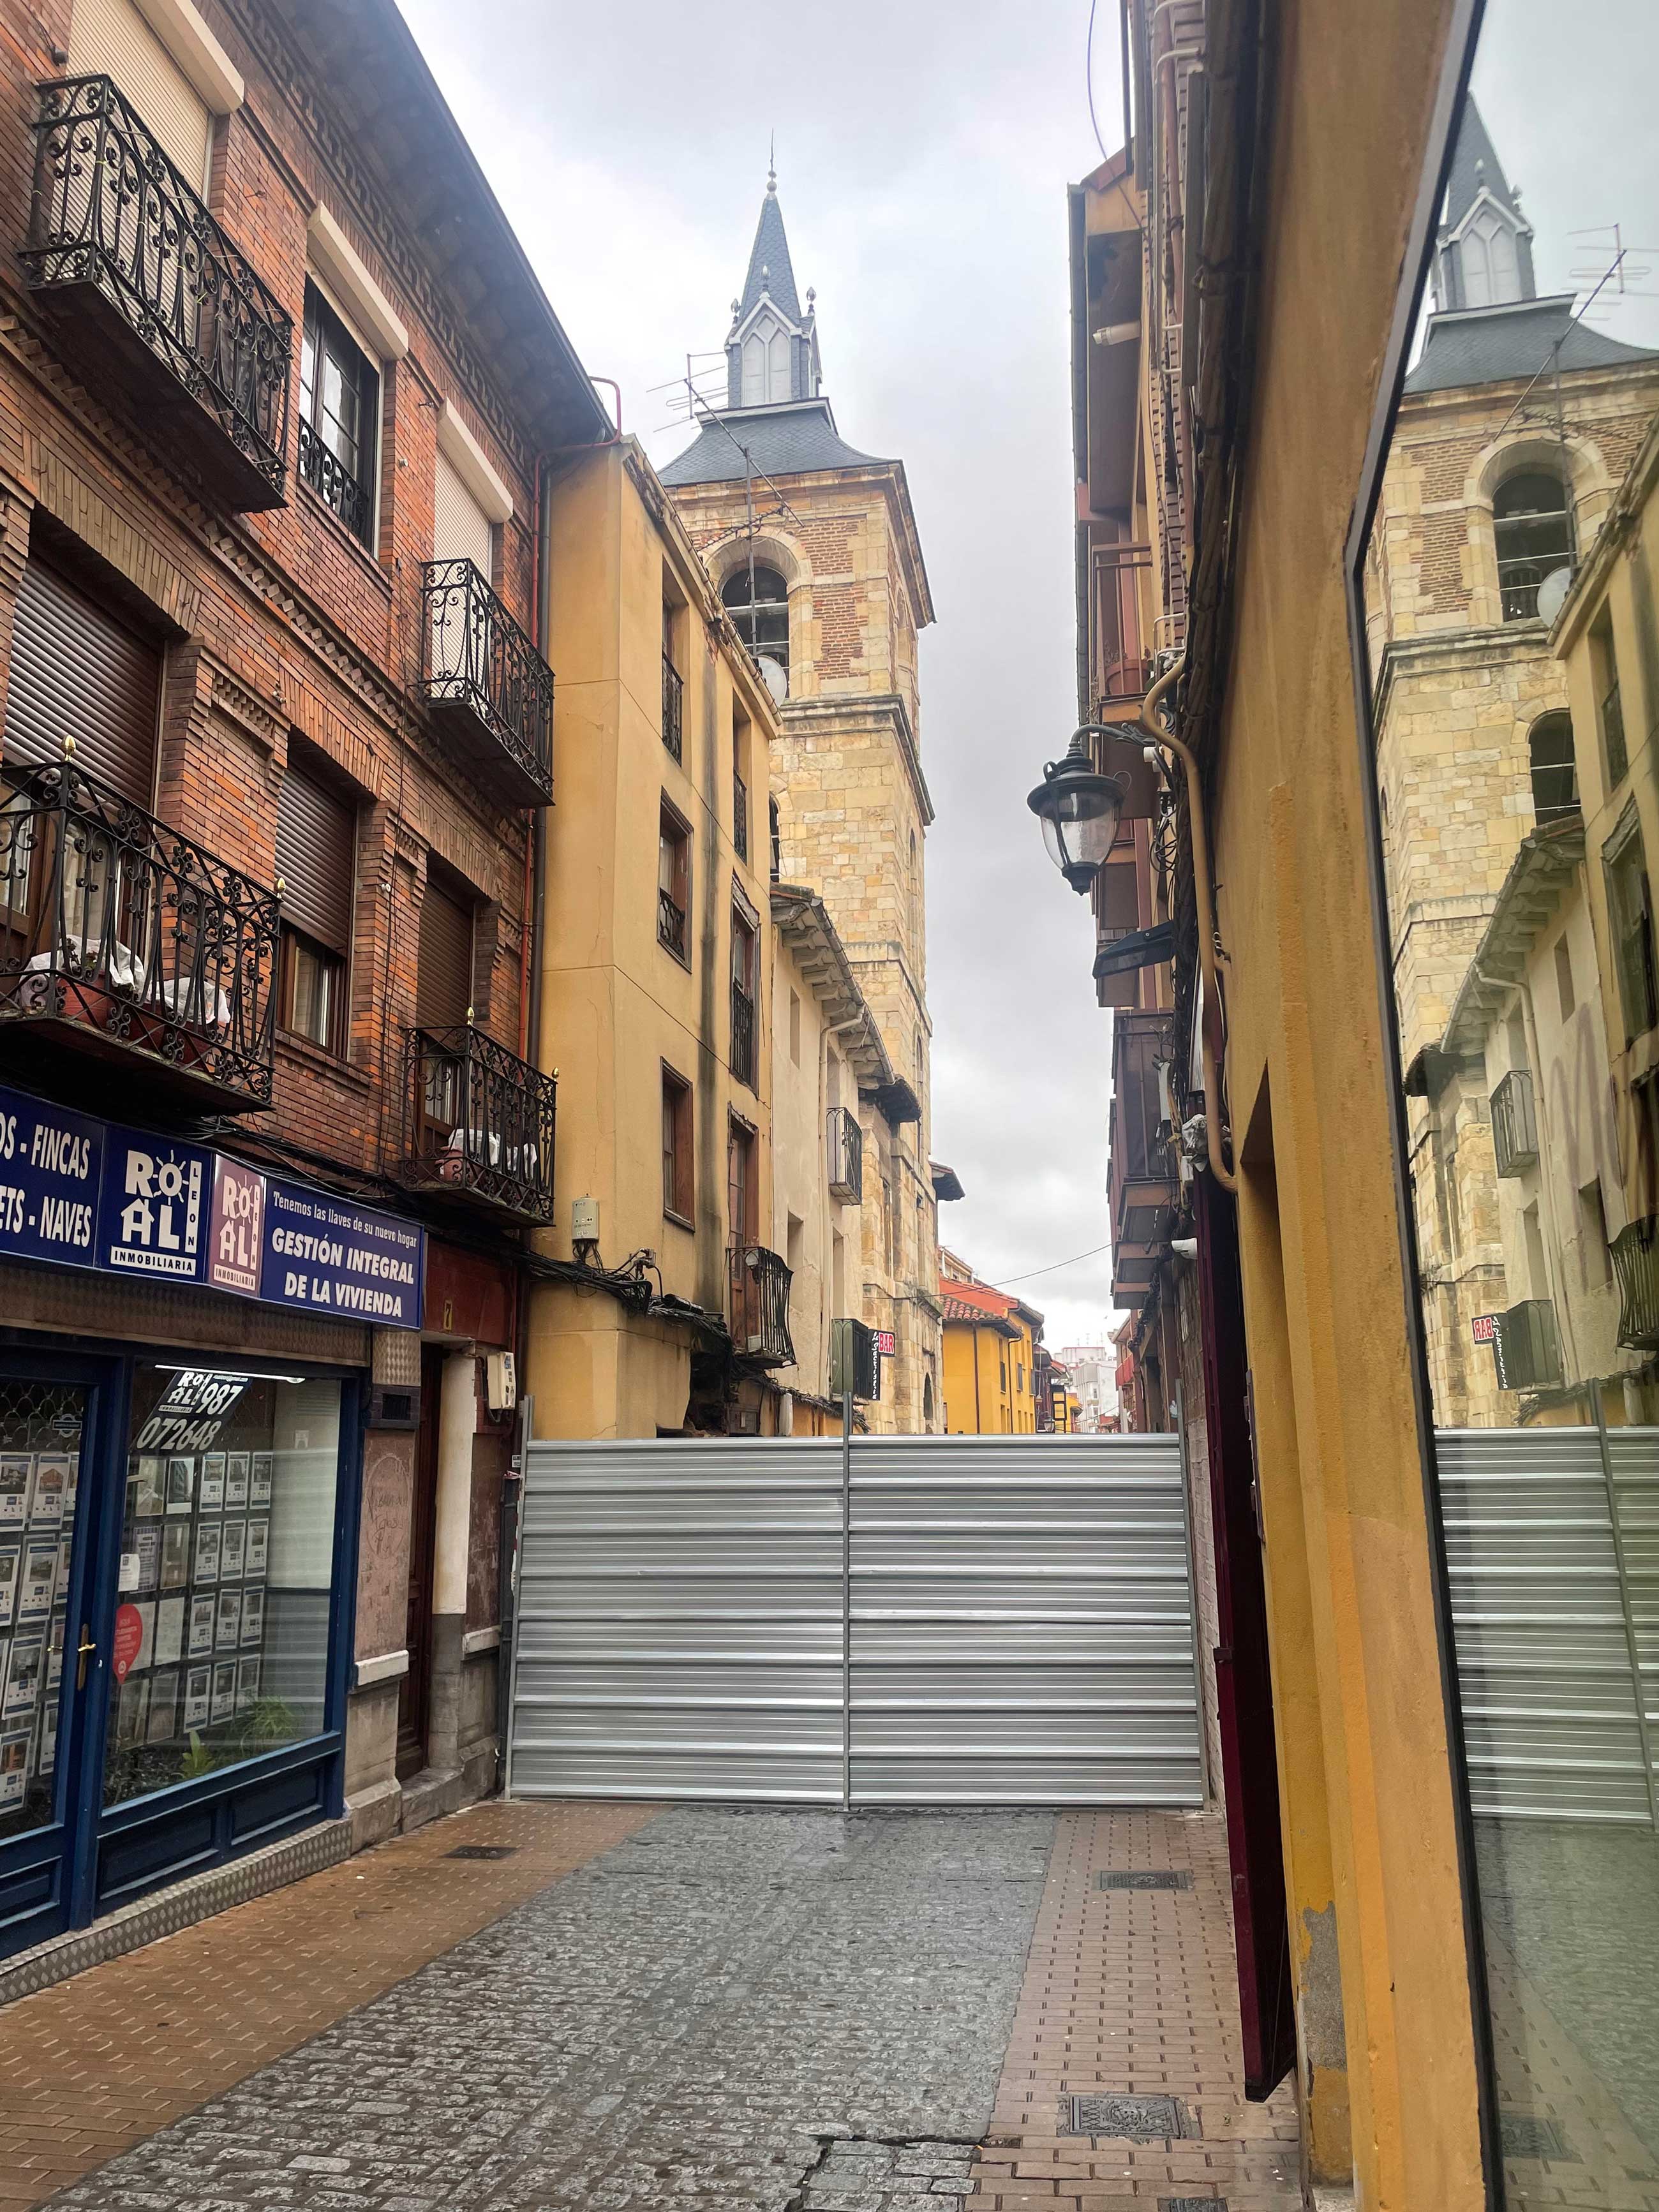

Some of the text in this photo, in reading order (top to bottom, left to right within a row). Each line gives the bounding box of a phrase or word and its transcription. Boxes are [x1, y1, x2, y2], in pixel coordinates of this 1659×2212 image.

[31, 1124, 91, 1180] FINCAS
[40, 1196, 93, 1247] NAVES
[121, 1198, 180, 1251] AL
[188, 1168, 198, 1246] LEON
[273, 1191, 417, 1249] Tenemos las llaves de su nuevo hogar
[114, 1251, 193, 1272] INMOBILIARIA
[219, 1220, 248, 1267] AL
[272, 1228, 414, 1284] GESTIÓN INTEGRAL
[216, 1268, 254, 1287] INMOBILIARIA
[284, 1272, 402, 1318] DE LA VIVIENDA
[444, 1305, 452, 1329] 7
[879, 1332, 895, 1354] BAR
[195, 1383, 244, 1416] 987
[136, 1416, 223, 1451] 072648
